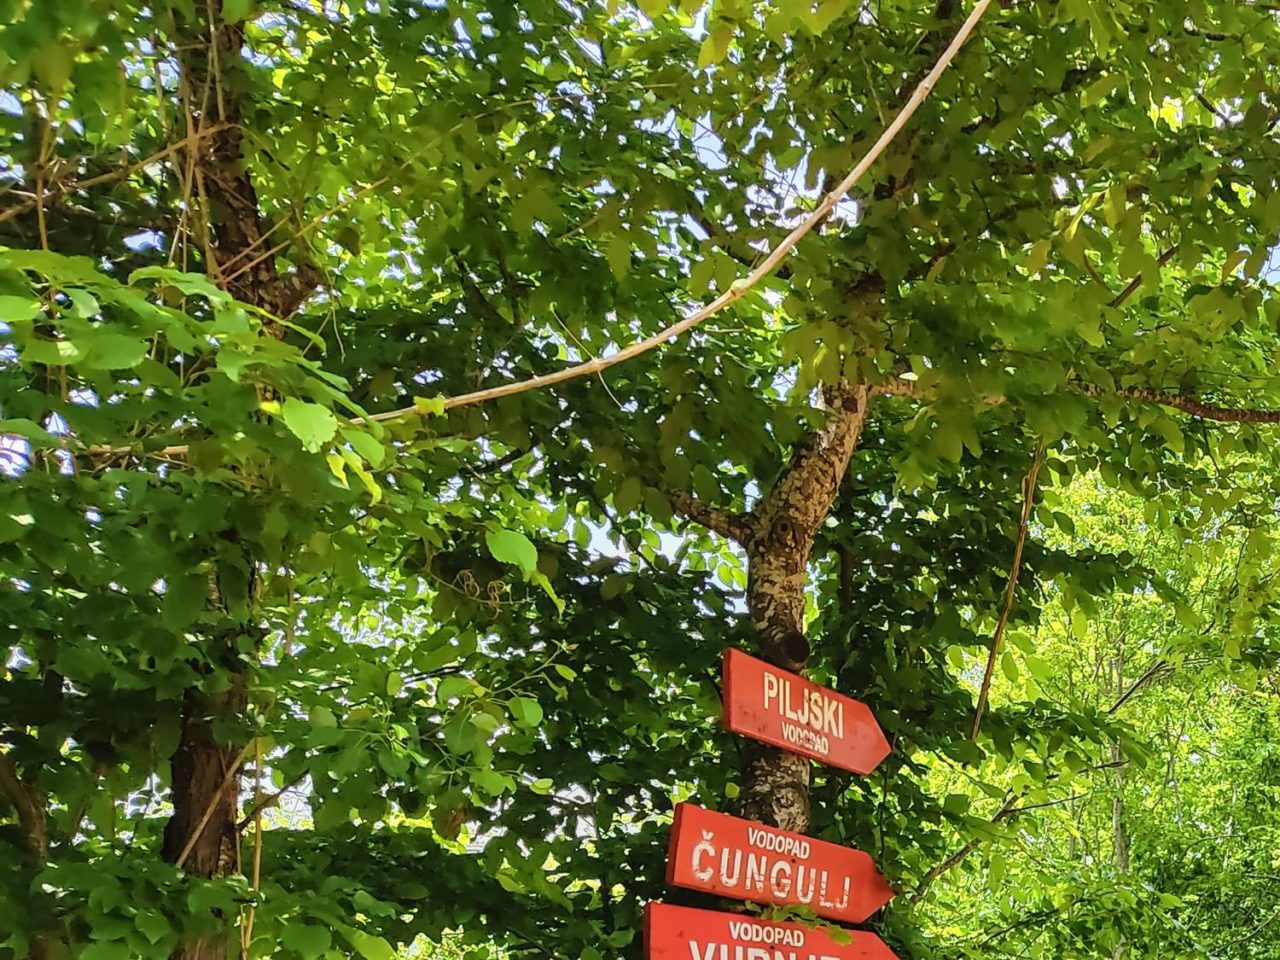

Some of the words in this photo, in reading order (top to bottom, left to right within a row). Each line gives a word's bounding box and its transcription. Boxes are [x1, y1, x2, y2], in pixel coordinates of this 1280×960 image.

[763, 671, 843, 739] PILJSKI
[781, 721, 829, 755] VODOPAD
[747, 827, 810, 859] VODOPAD
[691, 829, 850, 909] ČUNGULJ
[728, 921, 804, 947] VODOPAD
